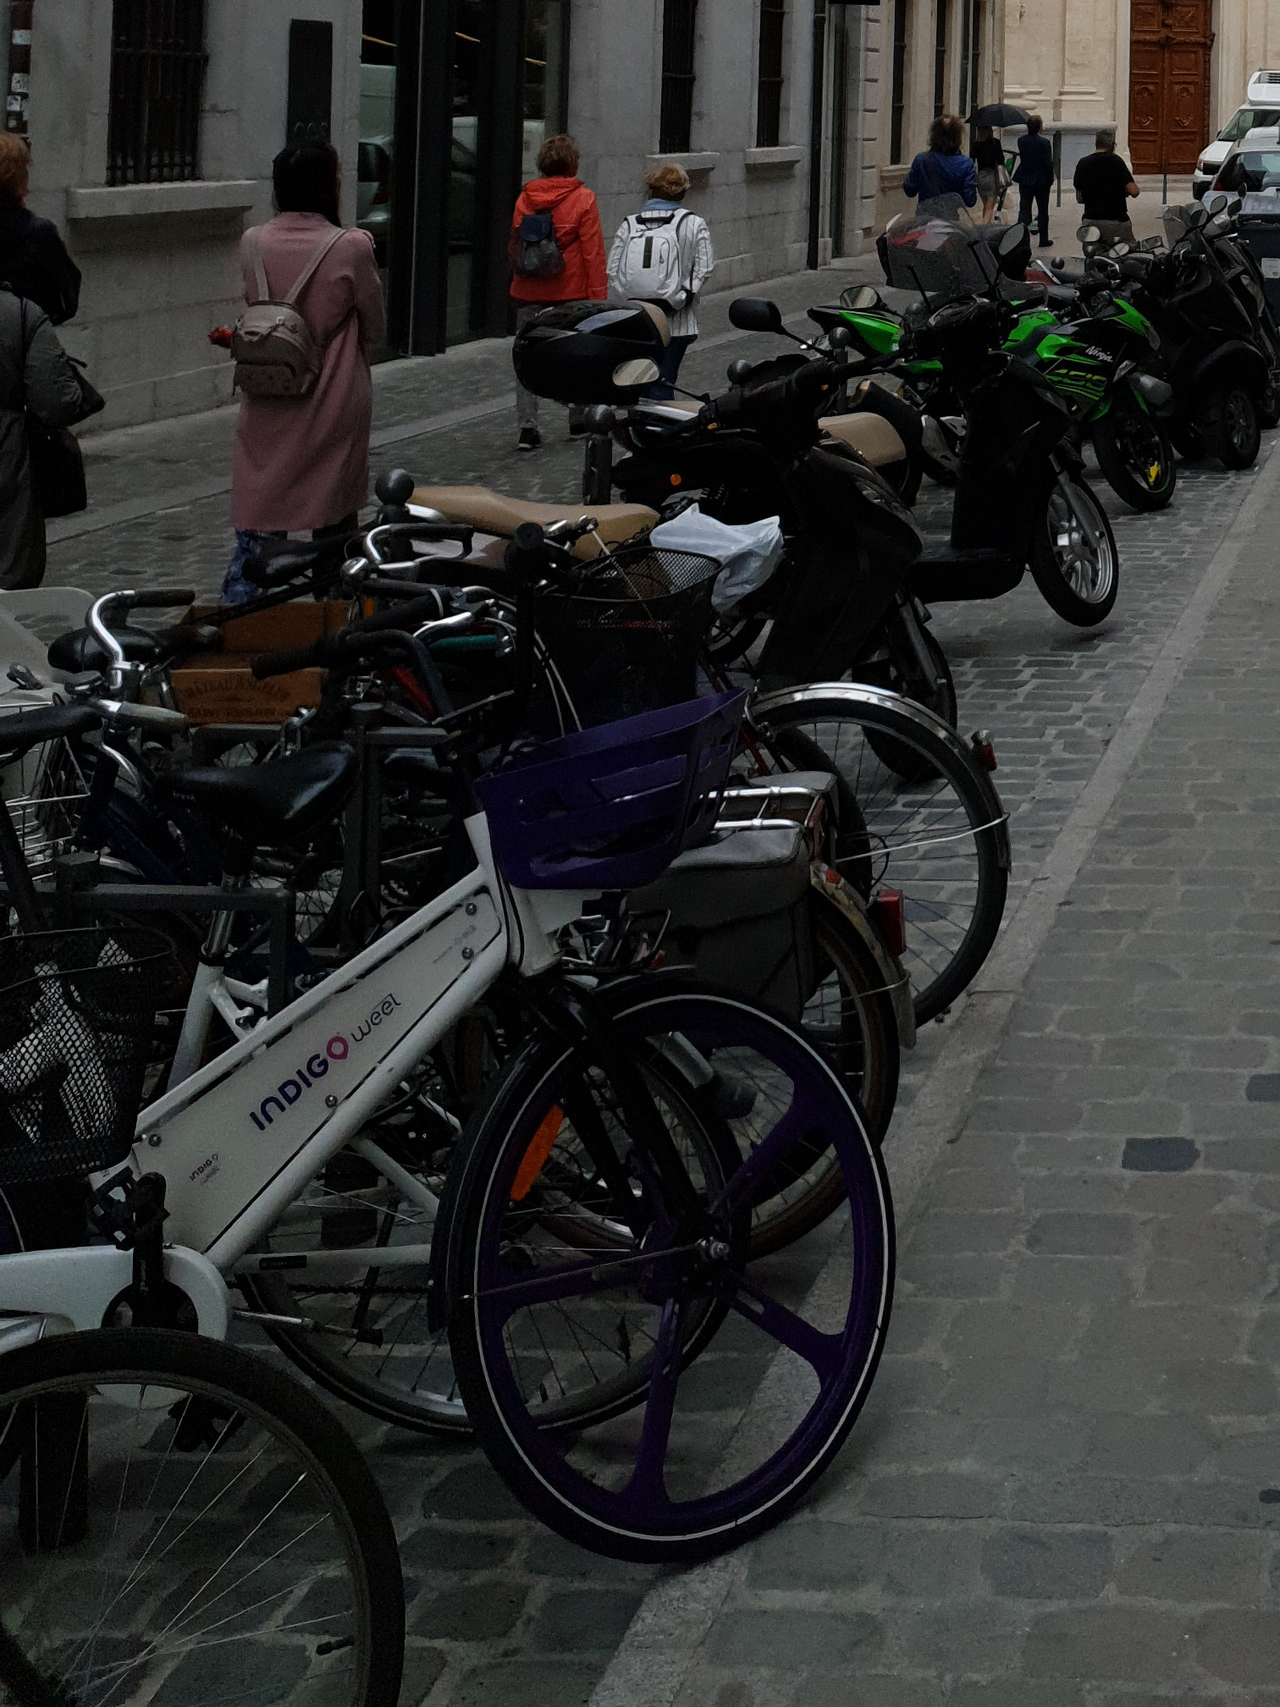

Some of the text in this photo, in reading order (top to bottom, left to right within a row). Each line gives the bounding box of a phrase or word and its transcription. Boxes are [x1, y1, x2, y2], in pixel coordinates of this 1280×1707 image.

[1085, 346, 1113, 363] Ninja
[249, 993, 402, 1131] INDIGO weel
[188, 1153, 219, 1182] INDIGO
